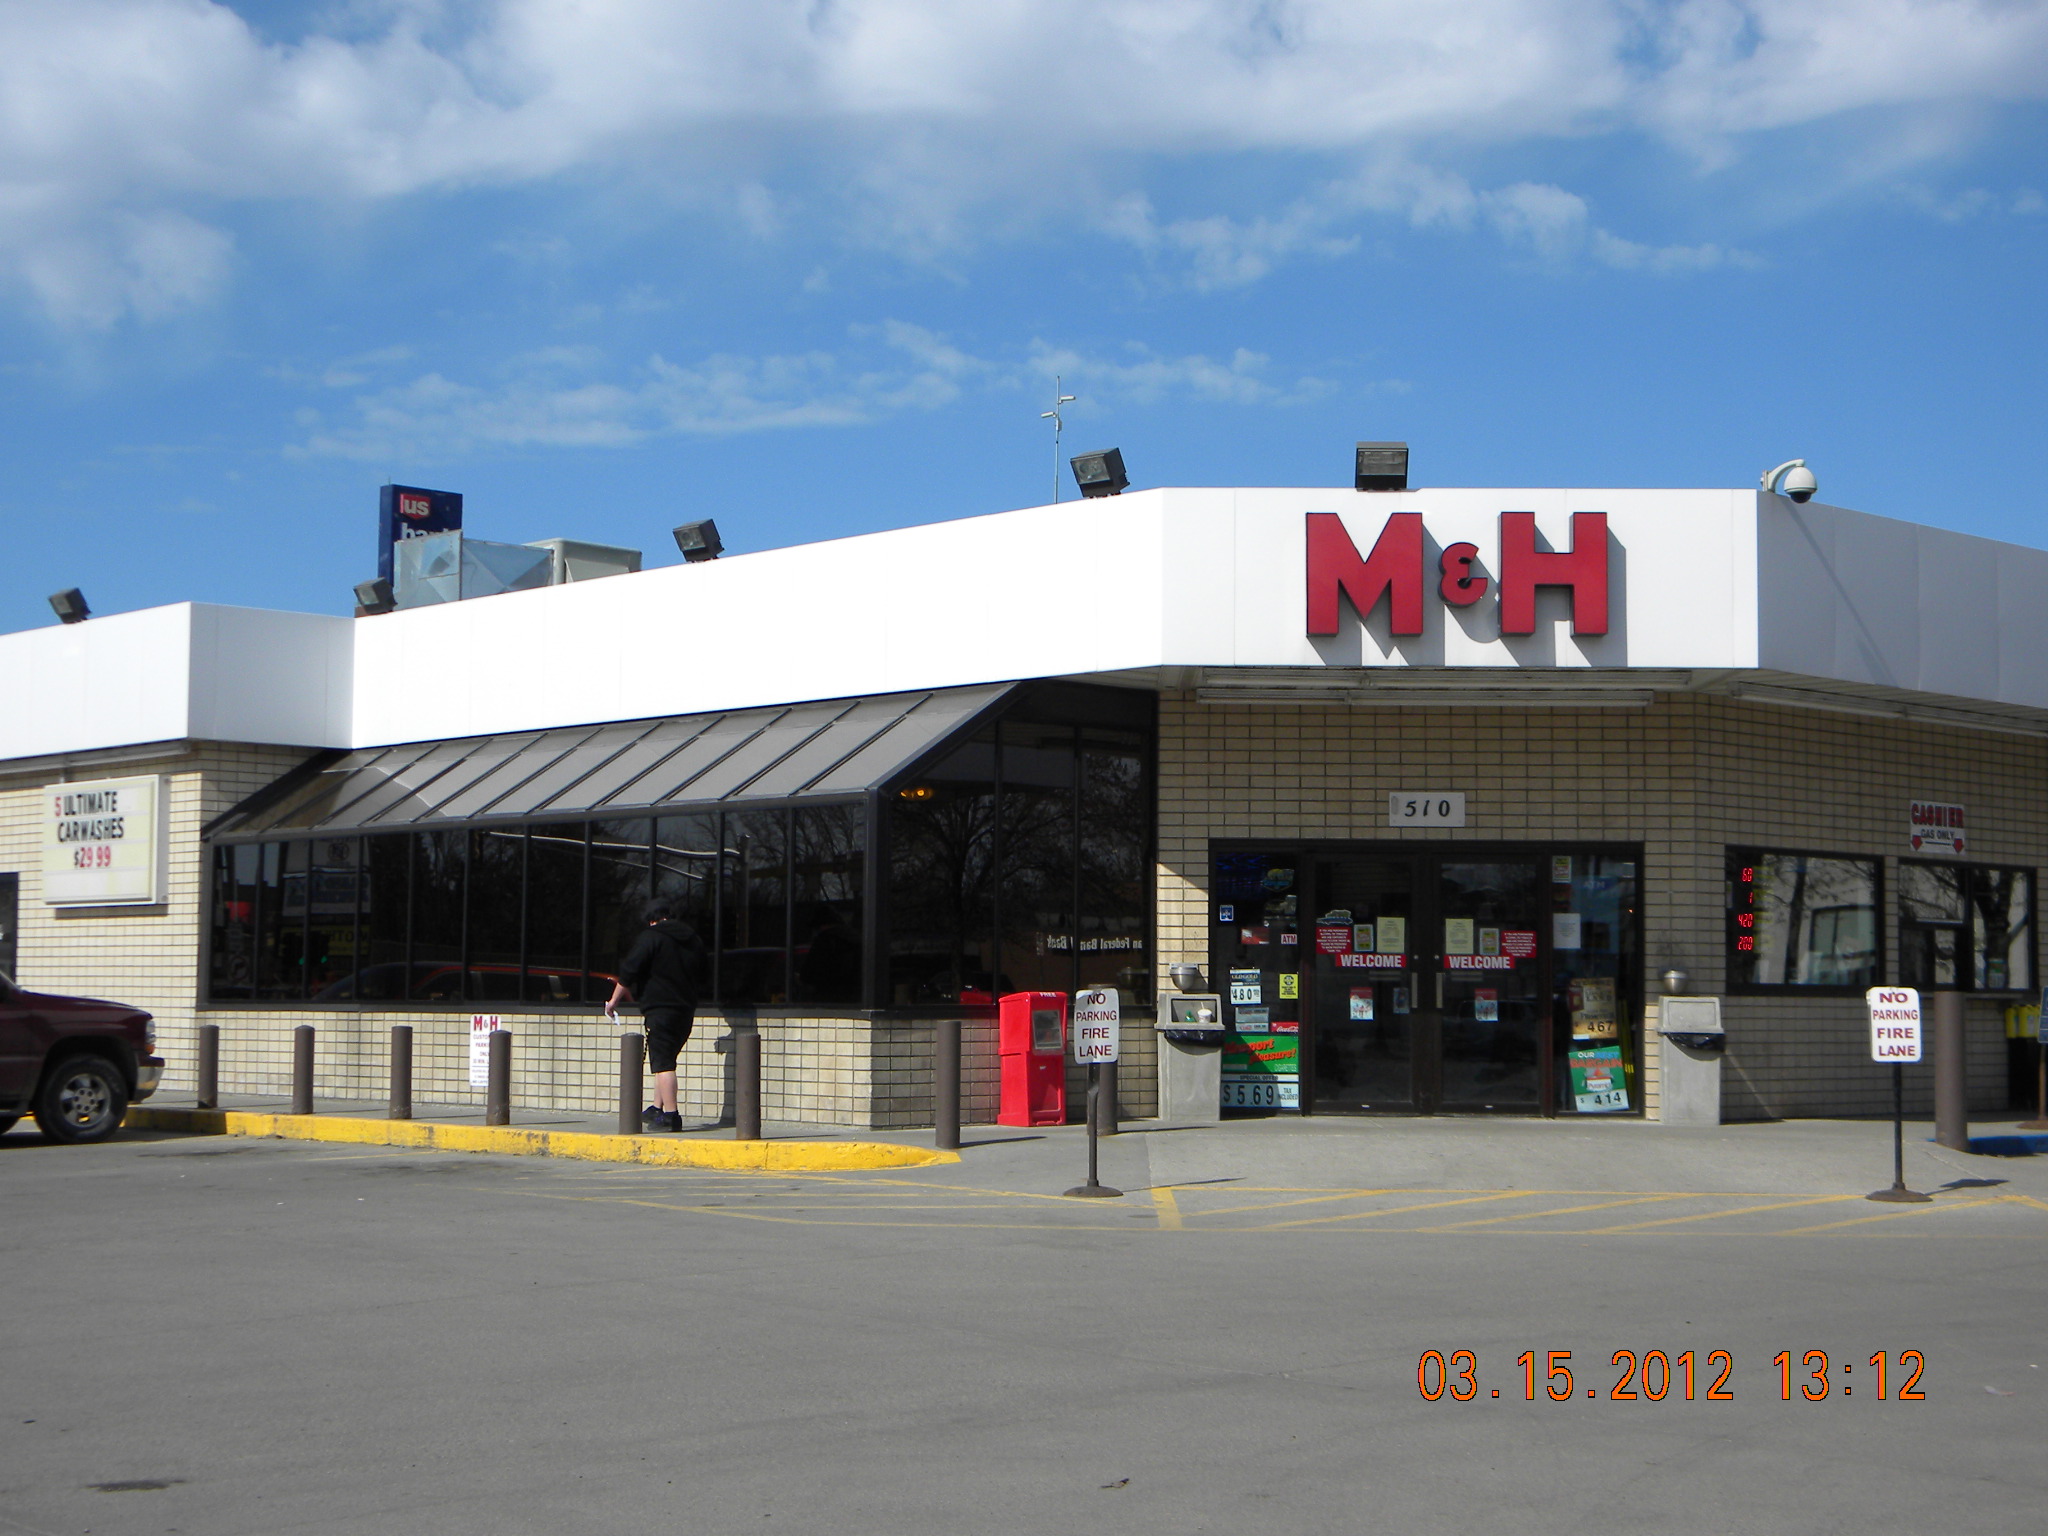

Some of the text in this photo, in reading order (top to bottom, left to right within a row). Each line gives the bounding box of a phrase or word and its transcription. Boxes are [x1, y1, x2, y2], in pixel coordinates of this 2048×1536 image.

[404, 499, 430, 516] us
[55, 791, 118, 816] 5 ULTIMATE
[1911, 803, 1964, 828] CASHIER
[58, 817, 124, 842] CARWASHES
[1921, 829, 1955, 840] GAS ONLY
[1738, 914, 1753, 928] 420
[1283, 935, 1297, 943] ATM
[1341, 955, 1402, 967] WELCOME
[1449, 956, 1511, 968] WELCOME
[1087, 993, 1106, 1005] NO
[1880, 993, 1908, 1003] NO
[1076, 1010, 1117, 1021] PARKING
[1873, 1010, 1918, 1020] PARKING
[1082, 1028, 1110, 1039] FIRE
[1877, 1028, 1915, 1039] FIRE
[1079, 1045, 1113, 1057] LANE
[1879, 1046, 1916, 1057] LANE
[1570, 1058, 1623, 1068] BARGAIN
